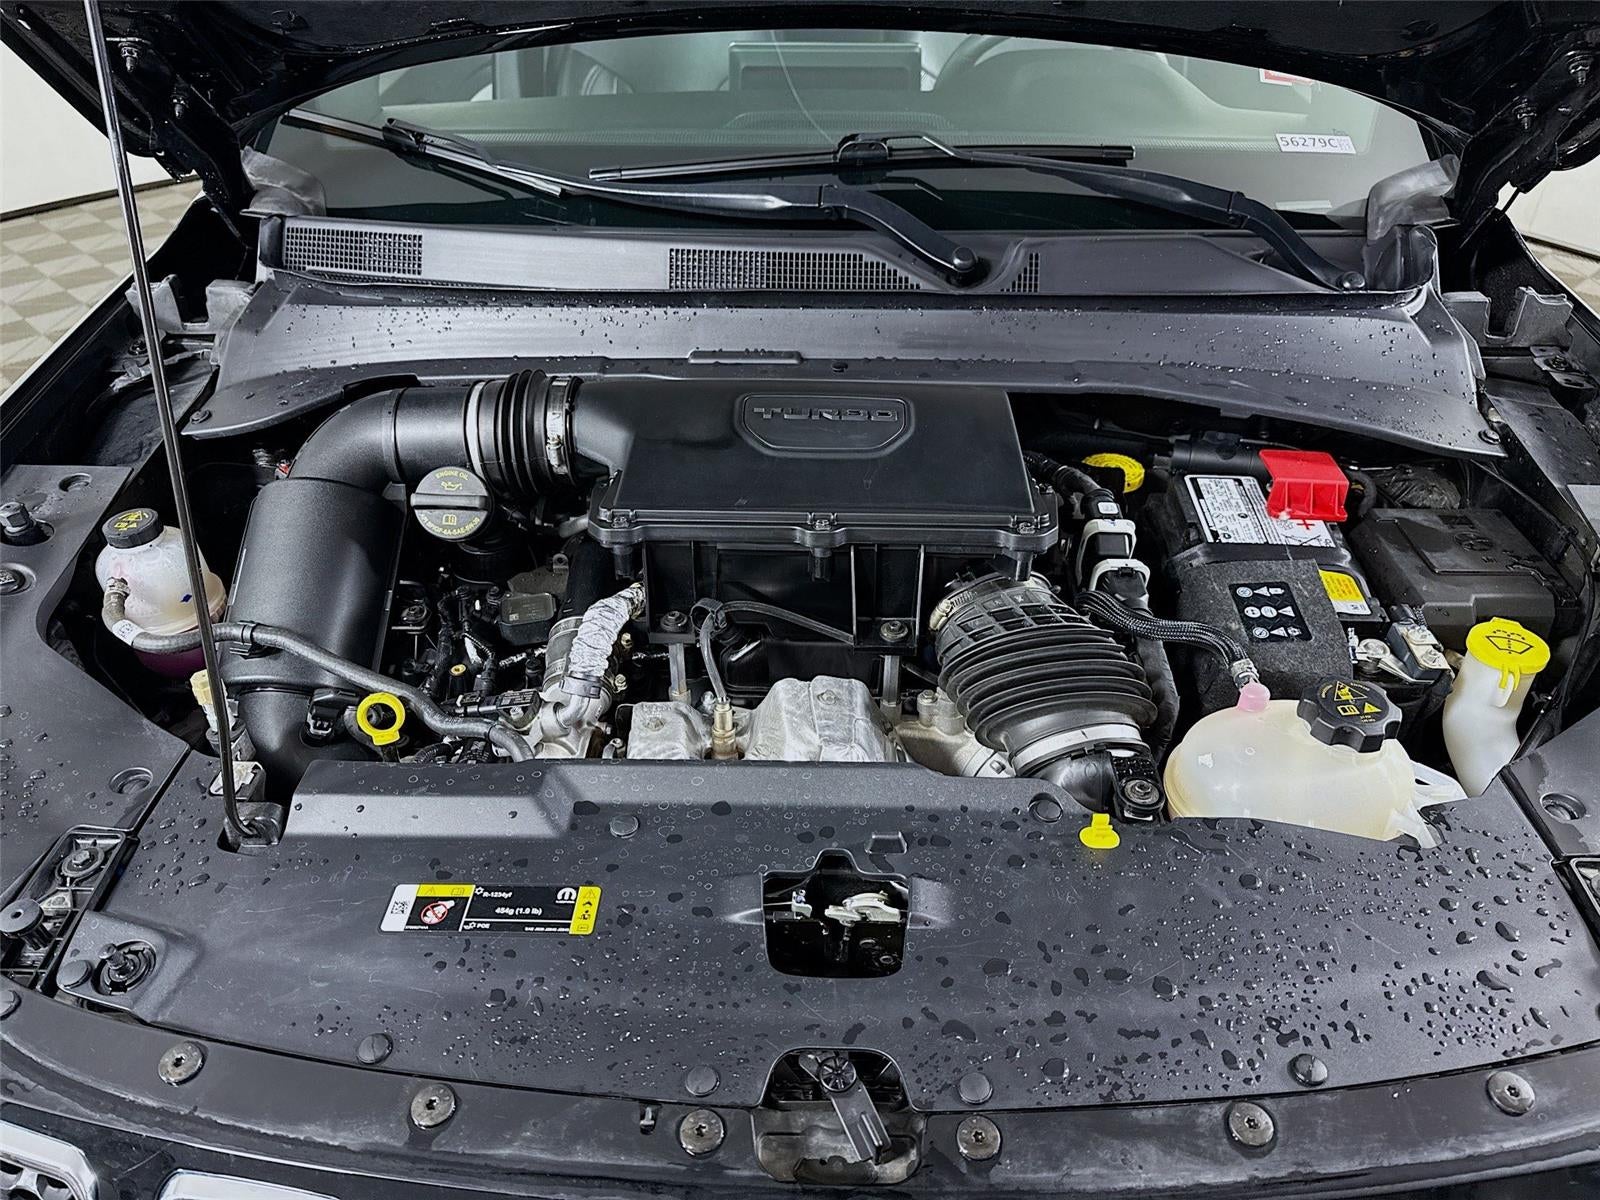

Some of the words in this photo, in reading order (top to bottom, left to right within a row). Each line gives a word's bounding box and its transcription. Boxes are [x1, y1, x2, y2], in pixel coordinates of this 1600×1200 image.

[1280, 136, 1338, 148] 56279C
[753, 407, 898, 421] TURBO
[435, 470, 459, 479] ENGINE
[459, 471, 469, 481] OIL
[482, 891, 513, 899] R-1234yf
[494, 907, 515, 915] 454g
